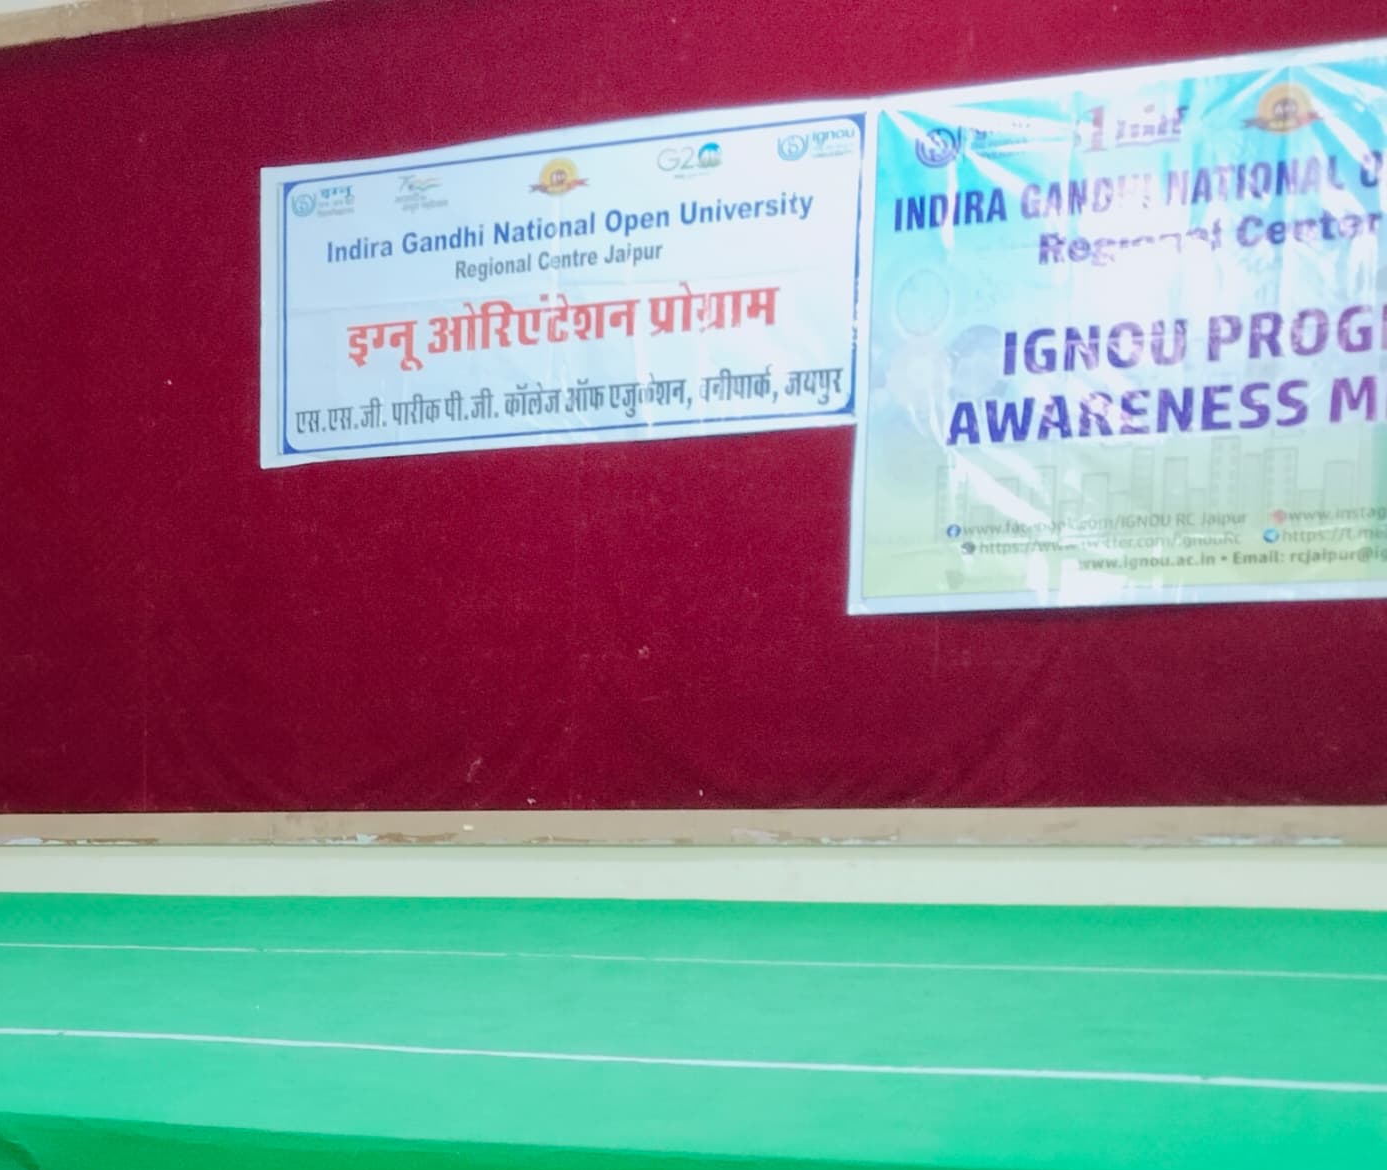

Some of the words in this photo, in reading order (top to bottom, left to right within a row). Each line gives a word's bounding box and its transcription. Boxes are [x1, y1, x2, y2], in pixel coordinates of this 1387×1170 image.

[326, 237, 394, 263] Indira
[401, 224, 485, 255] Gandhi
[493, 211, 596, 245] National
[604, 208, 671, 237] Open
[679, 191, 814, 225] University
[893, 187, 1008, 233] INDIRA
[1019, 171, 1153, 221] GAND
[1166, 154, 1345, 206] NATIONAL
[454, 253, 532, 282] Regional
[537, 249, 599, 271] Centre
[603, 242, 664, 267] Jaipur
[346, 319, 424, 372] इग्नू
[427, 292, 641, 355] ओरिएंटेशन
[647, 280, 781, 337] प्रोग्राम
[1002, 317, 1188, 377] IGNOU
[1206, 303, 1387, 363] PROG
[391, 393, 441, 426] पारीक
[504, 382, 563, 417] कॉलेज
[565, 377, 606, 413] ऑफ
[784, 367, 844, 406] जयपुर
[944, 378, 1309, 446] AWARENESS
[1328, 373, 1387, 424] M
[1232, 549, 1286, 566] Email:
